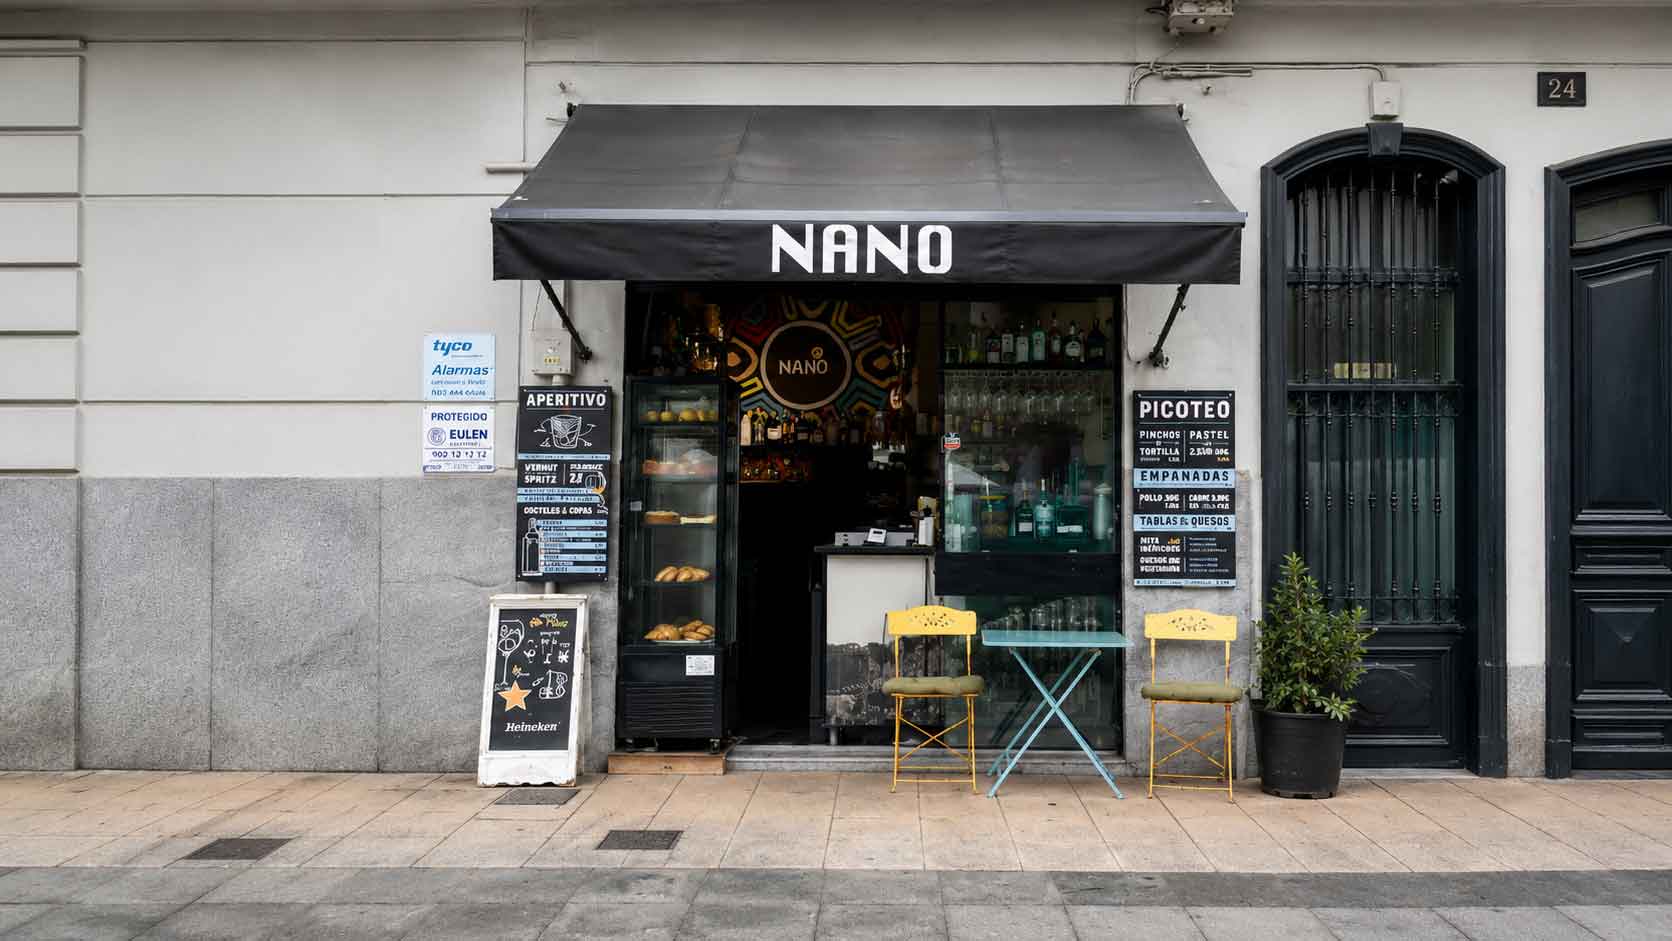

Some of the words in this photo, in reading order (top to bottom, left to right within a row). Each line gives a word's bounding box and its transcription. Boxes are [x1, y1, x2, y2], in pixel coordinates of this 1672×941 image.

[1549, 79, 1576, 98] 24
[771, 224, 953, 274] NANO
[433, 339, 473, 356] tyco
[432, 364, 489, 376] Alarmas
[778, 359, 828, 375] NANO
[526, 393, 606, 406] APERITIVO
[1139, 400, 1230, 418] PICOTEO
[449, 429, 488, 439] EULEN
[1140, 430, 1180, 439] PINCHOS
[1190, 430, 1229, 440] PASTEL
[1140, 447, 1180, 456] TORTILLA
[524, 475, 557, 484] SPRITZ
[1140, 471, 1229, 481] EMPANADAS
[1140, 494, 1163, 502] POLLO
[1140, 516, 1178, 525] TABLAS
[1191, 516, 1229, 526] QUESOS
[505, 722, 557, 732] Heineken
